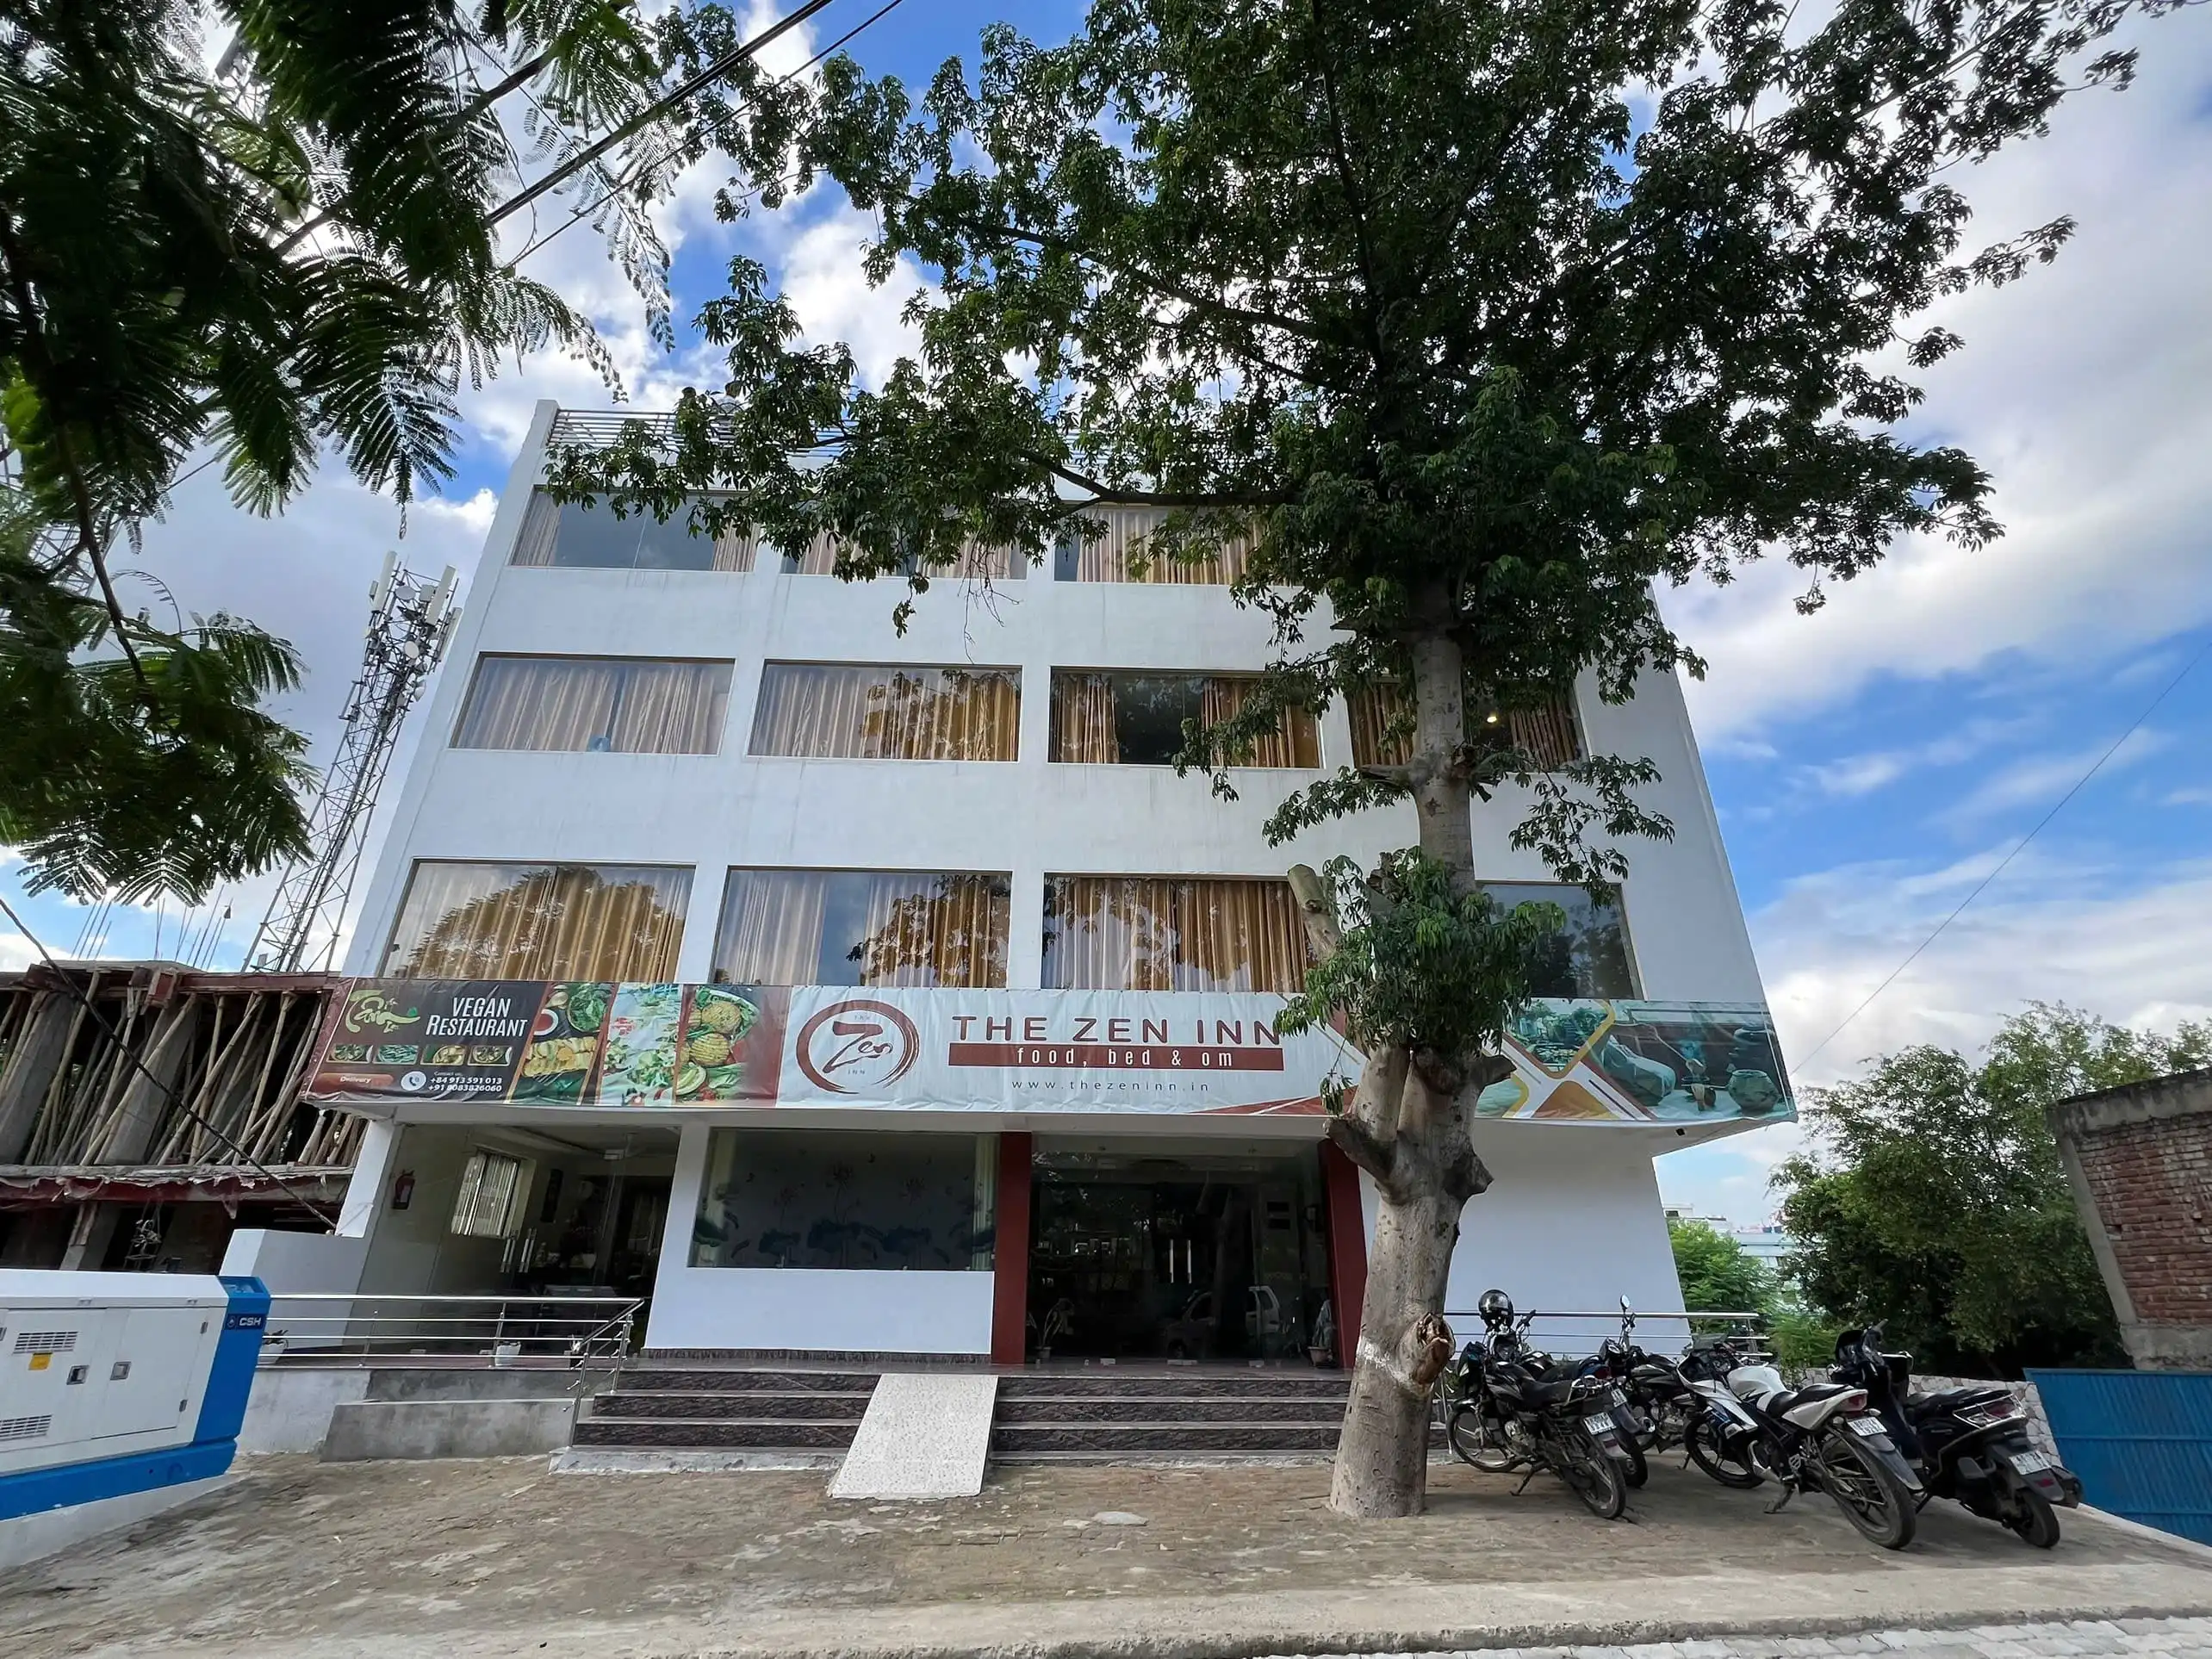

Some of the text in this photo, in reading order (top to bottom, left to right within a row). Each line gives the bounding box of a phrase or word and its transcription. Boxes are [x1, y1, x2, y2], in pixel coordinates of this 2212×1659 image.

[451, 997, 512, 1018] VEGAN
[952, 1016, 1280, 1046] THE ZEN INN
[822, 1021, 893, 1074] Zen
[1017, 1047, 1233, 1067] food, bed & om
[1011, 1080, 1209, 1091] www.thezeninn.in
[239, 1317, 262, 1327] CSH
